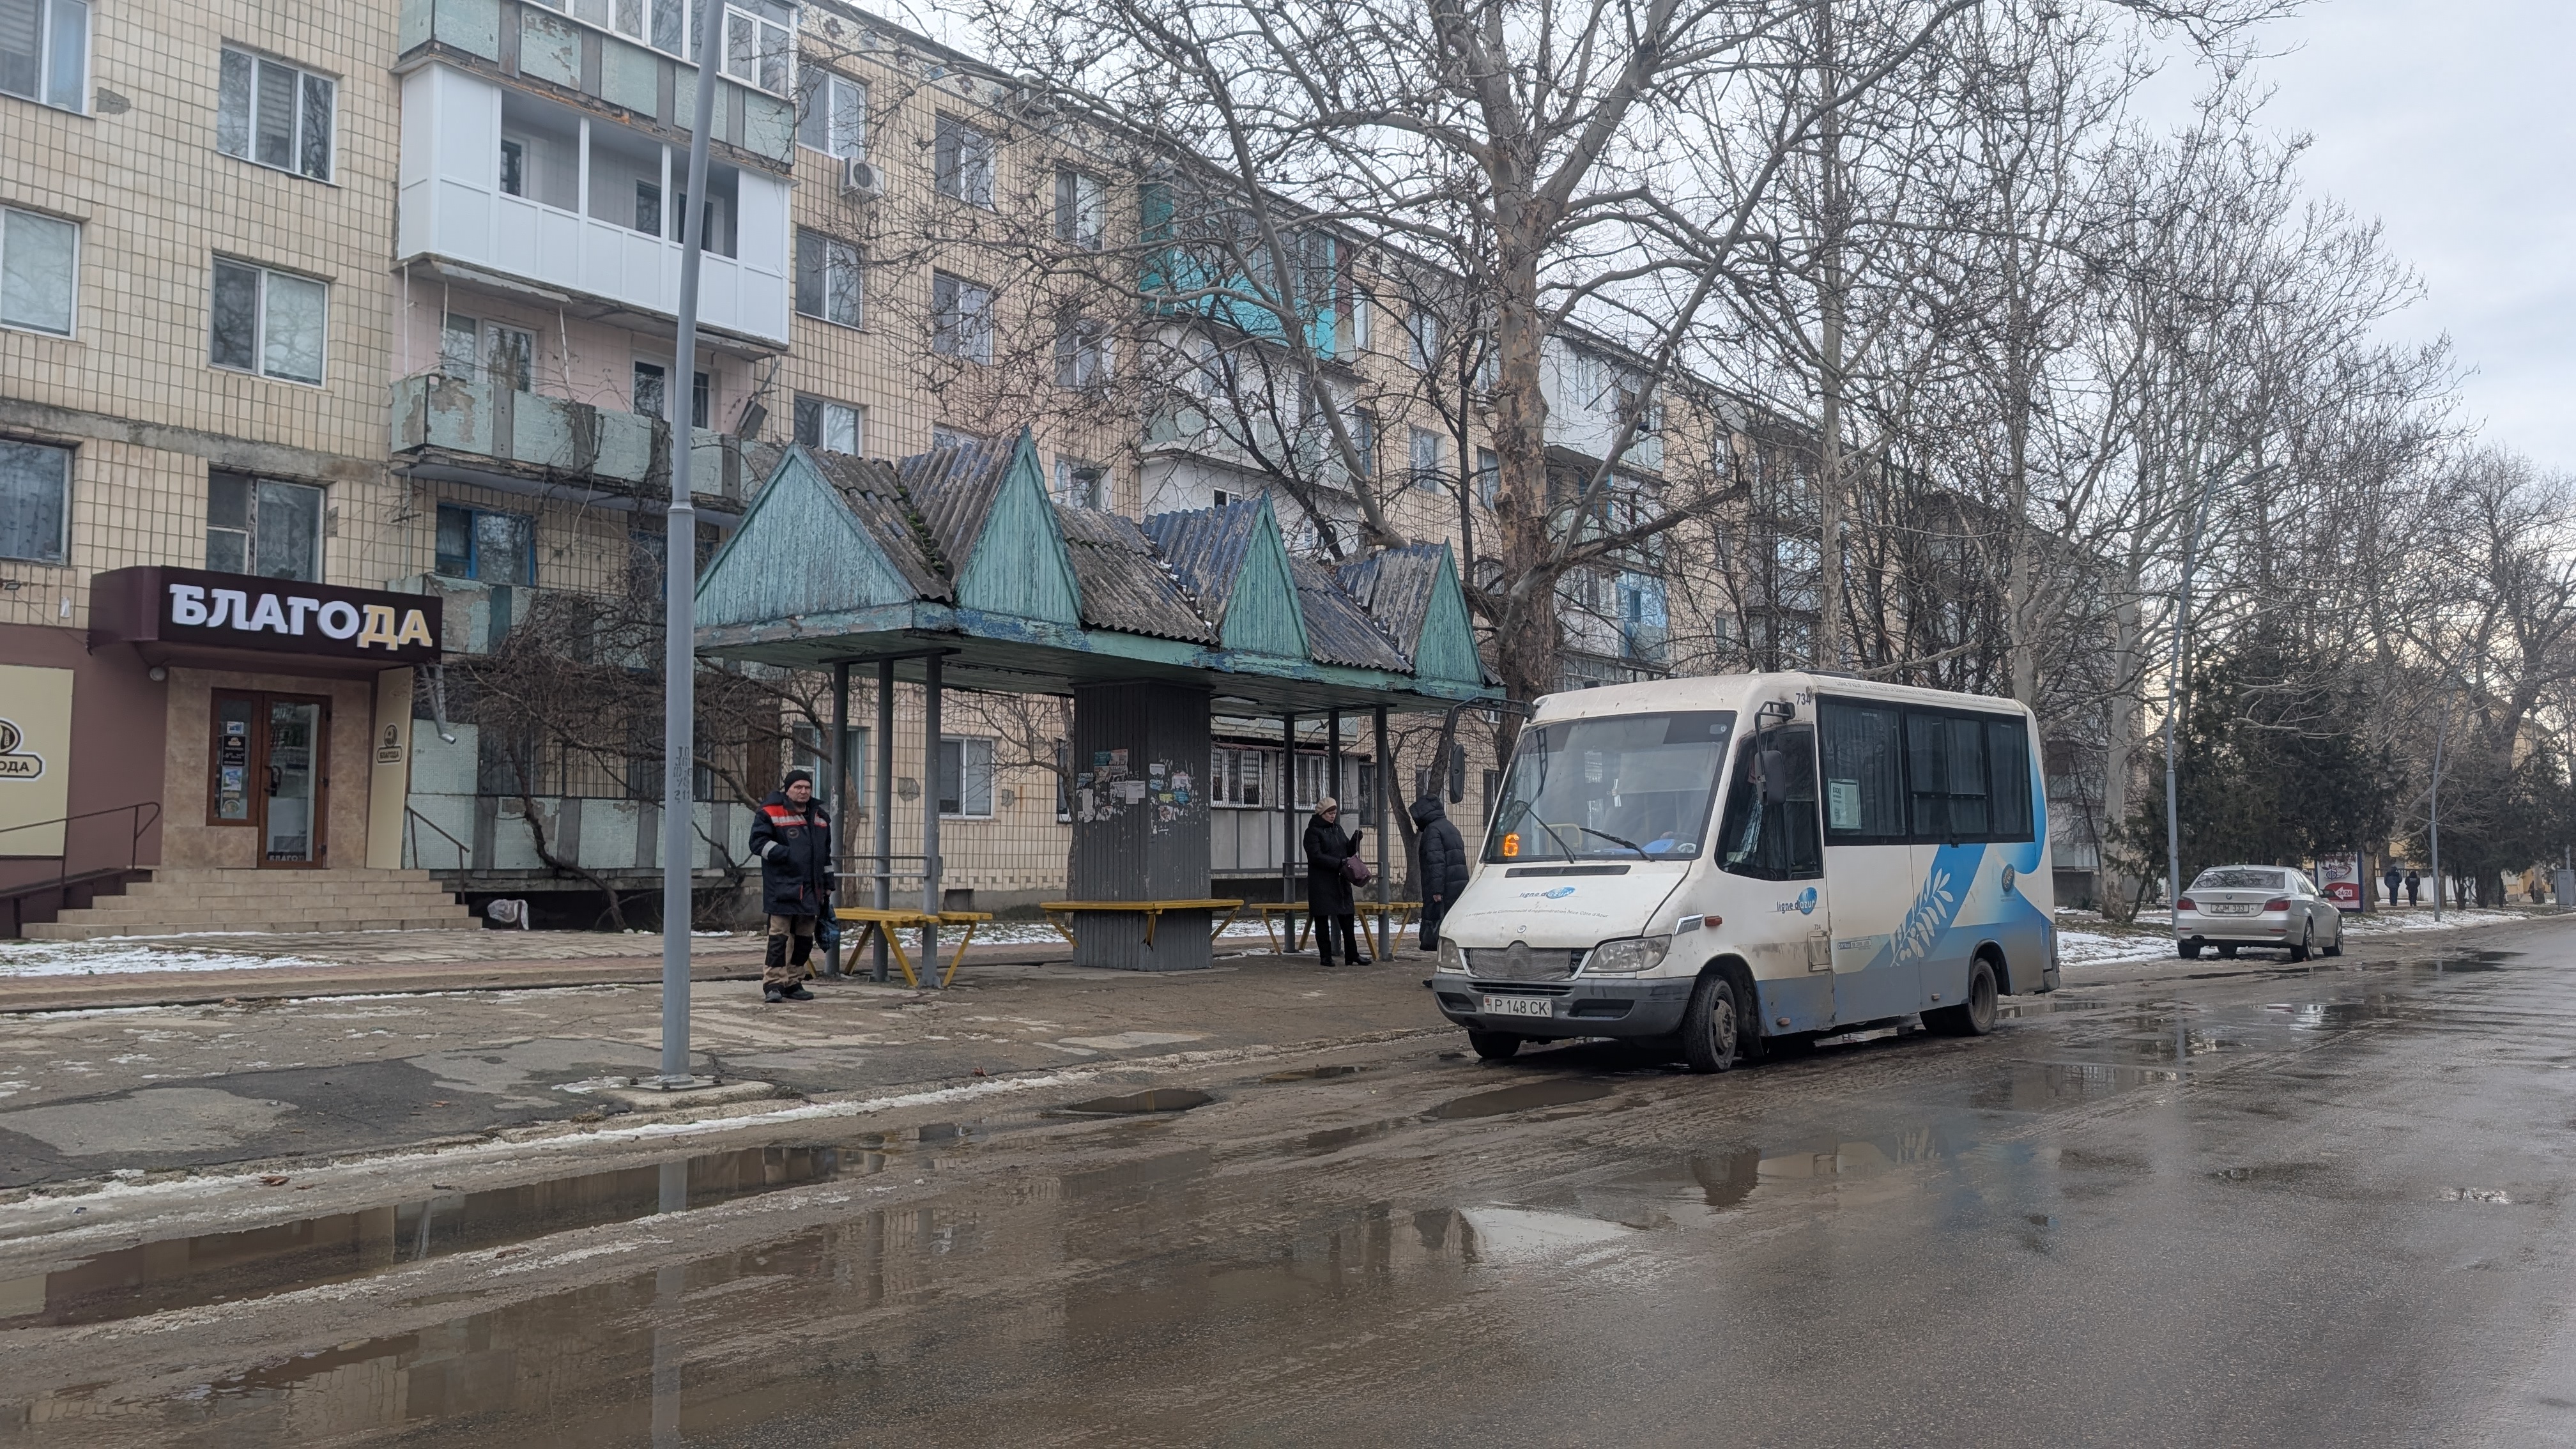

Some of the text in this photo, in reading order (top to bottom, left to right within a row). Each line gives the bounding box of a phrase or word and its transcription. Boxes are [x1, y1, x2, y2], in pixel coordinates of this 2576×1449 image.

[169, 583, 433, 650] БЛАГОДА
[1795, 693, 1811, 705] 734
[1504, 834, 1519, 856] 6
[1776, 901, 1793, 914] ligne
[1494, 999, 1547, 1015] P 148 CK
